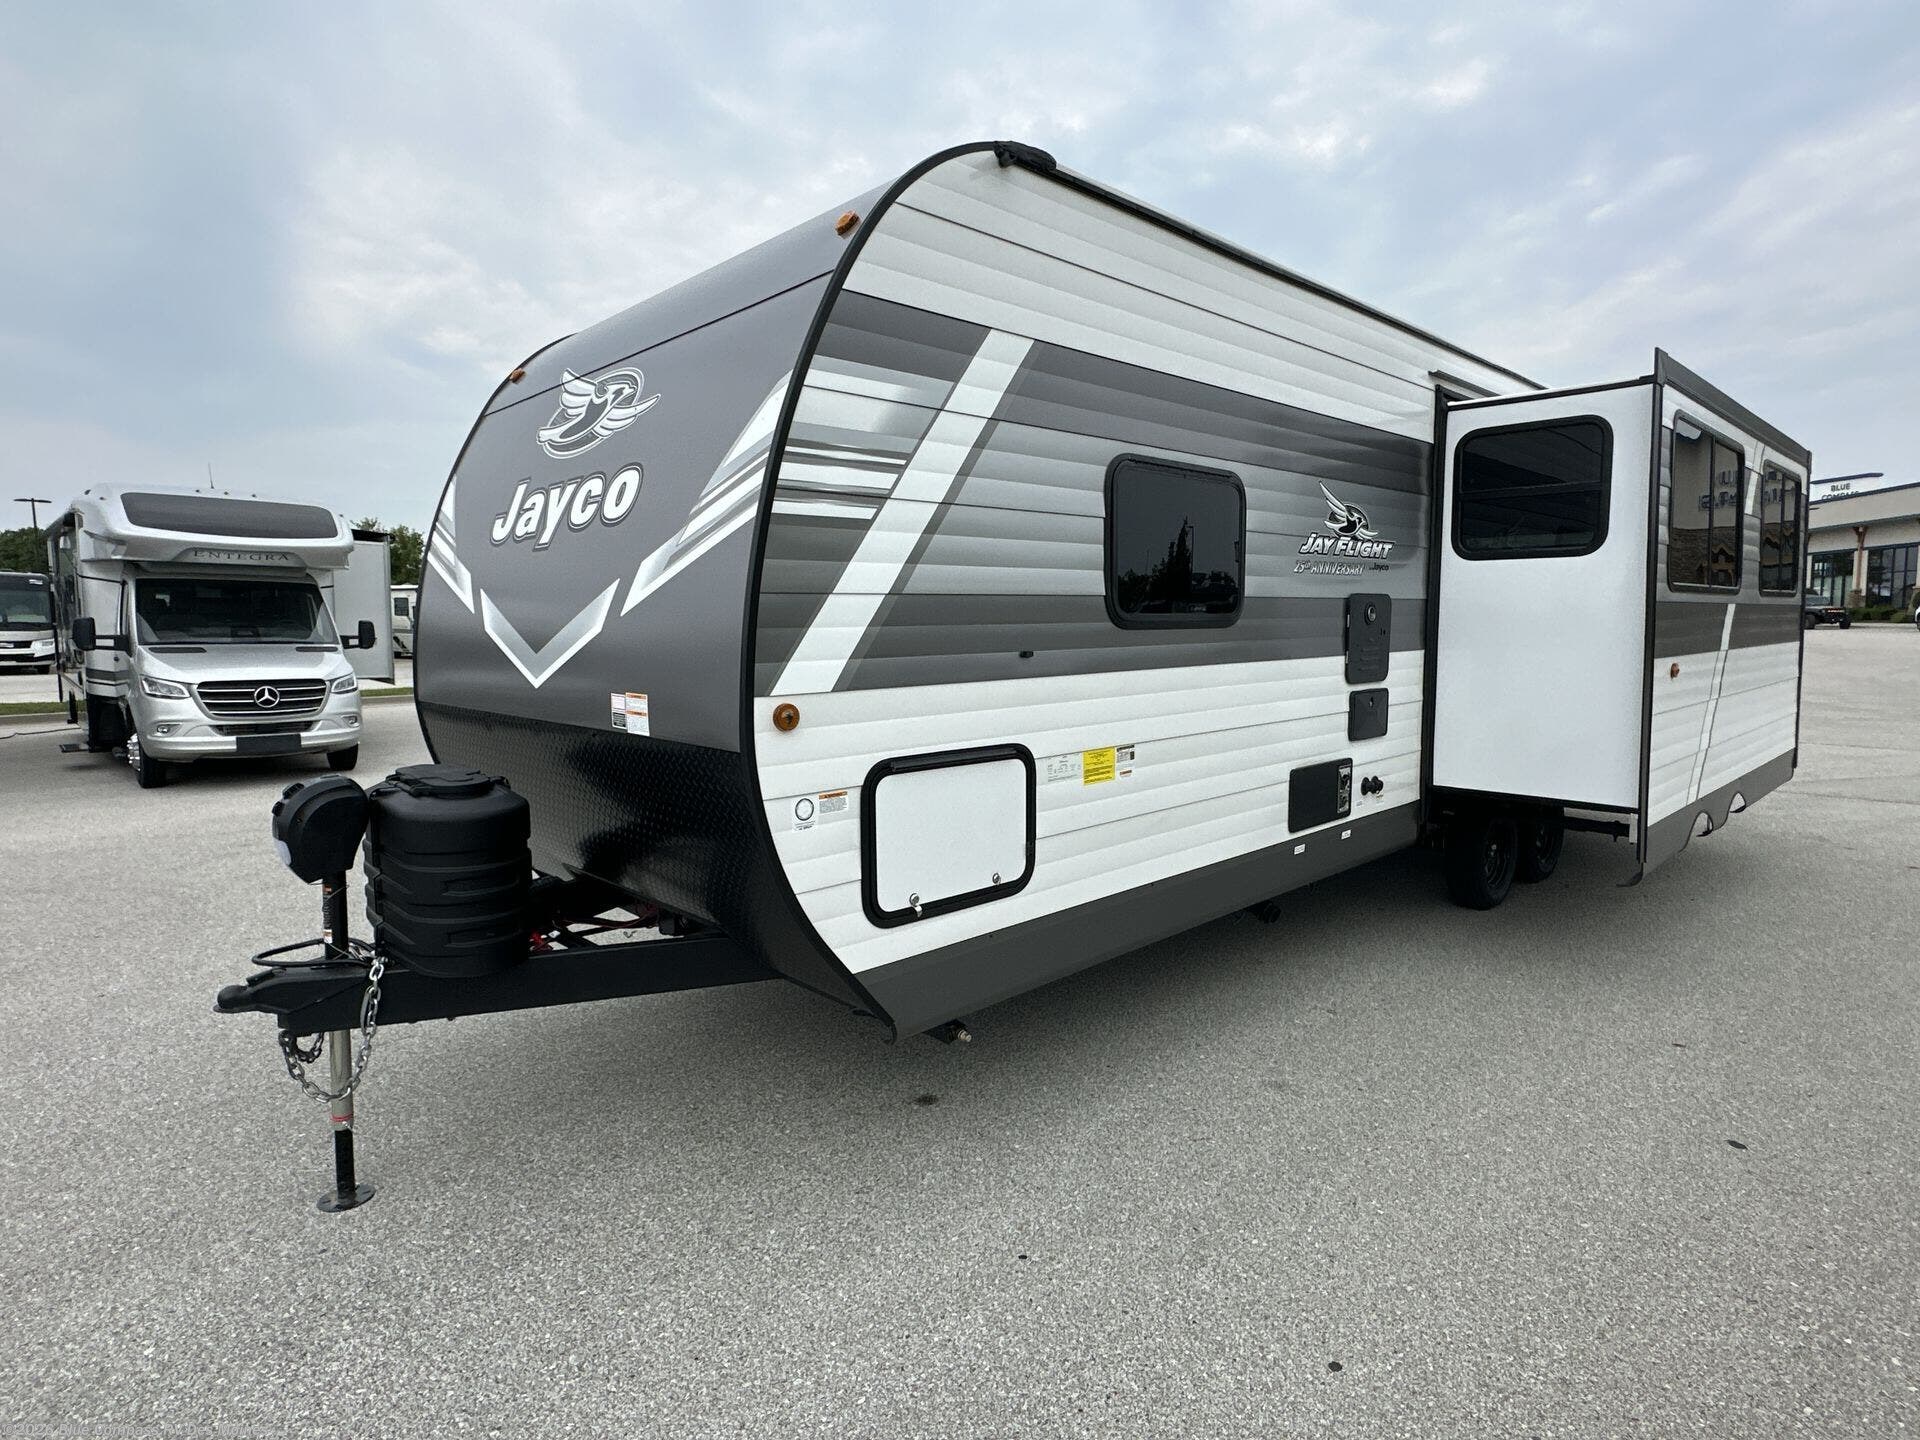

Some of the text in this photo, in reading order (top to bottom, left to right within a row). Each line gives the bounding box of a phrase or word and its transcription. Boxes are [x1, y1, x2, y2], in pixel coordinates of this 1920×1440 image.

[1831, 483, 1851, 492] BLUE
[491, 462, 643, 551] Jayco
[1299, 532, 1394, 559] JAY FLIGHT
[193, 549, 289, 561] ENTEGRA
[1311, 560, 1364, 576] ANNIVERSARY
